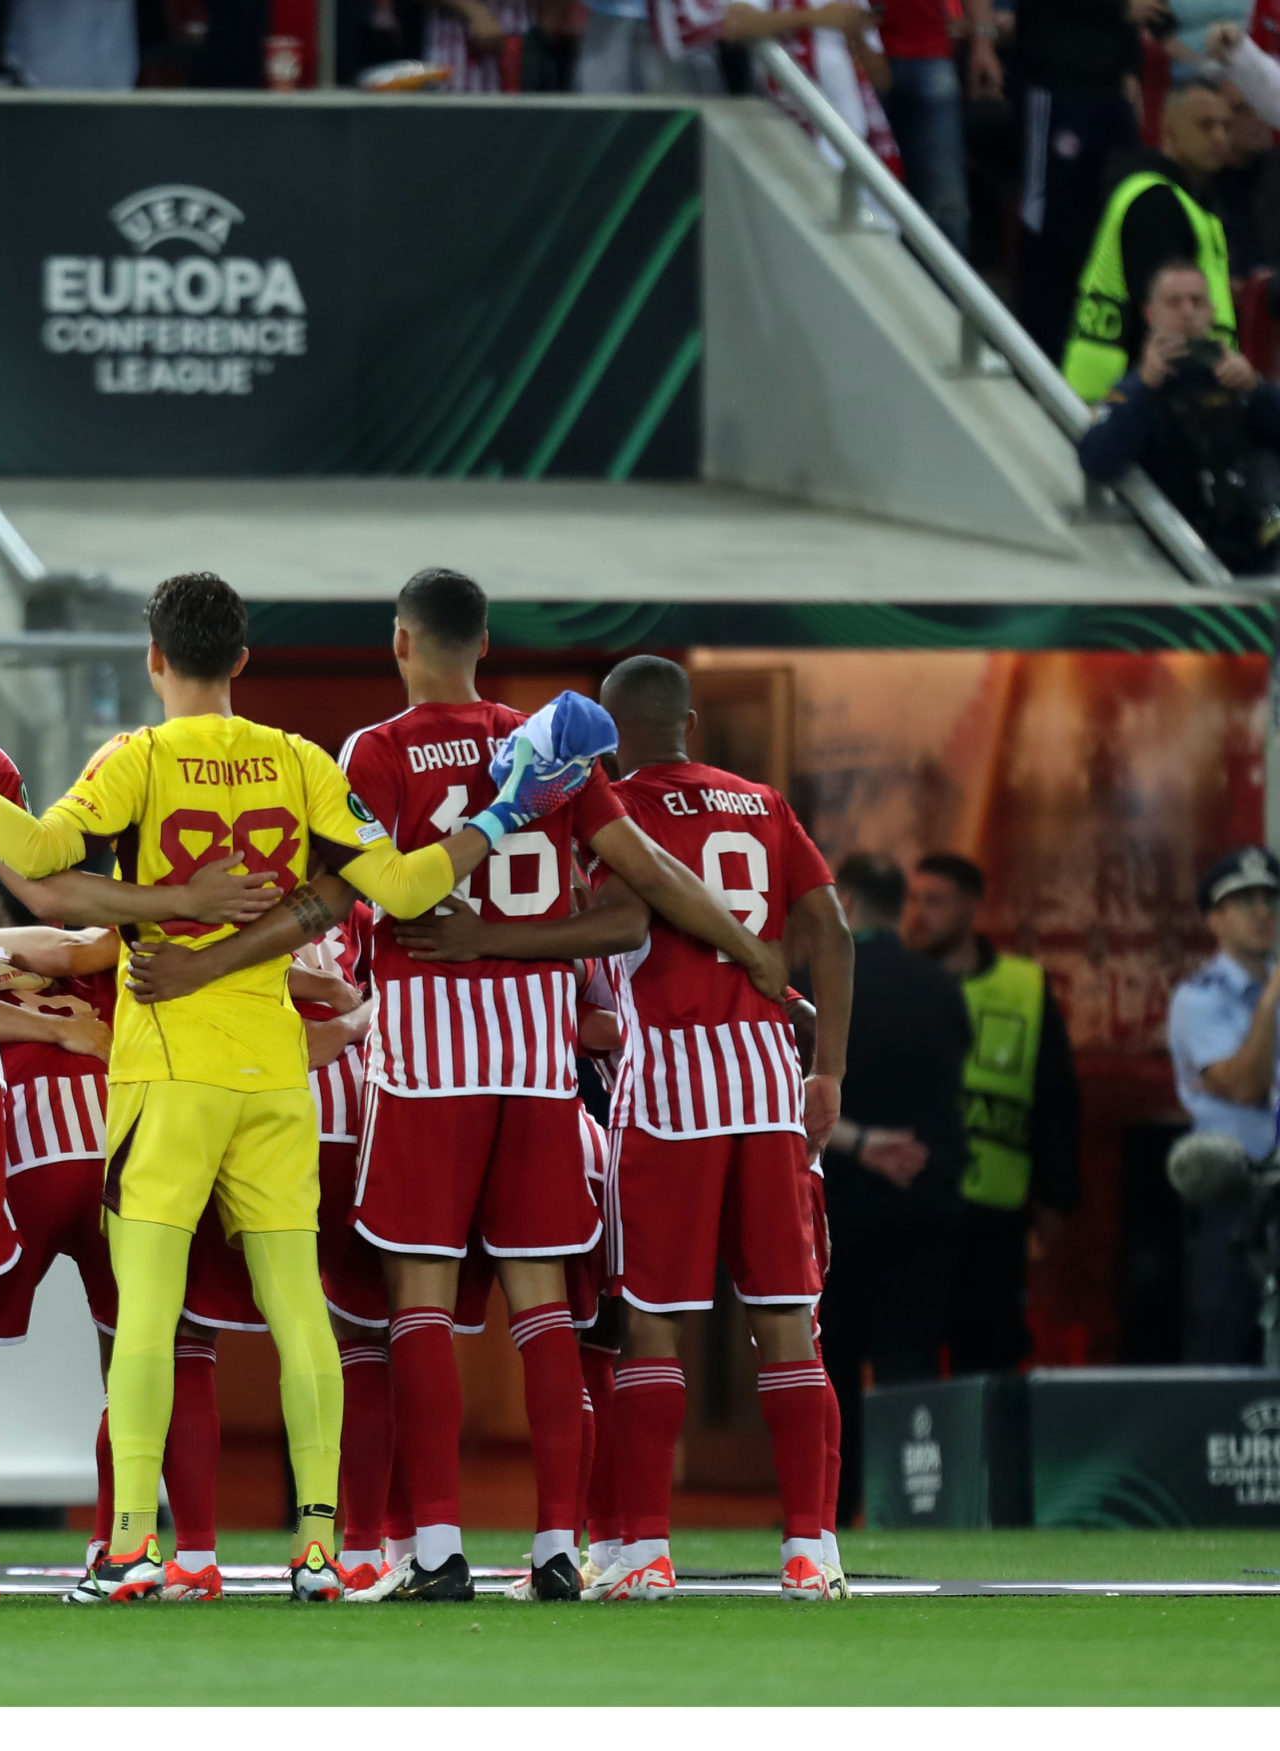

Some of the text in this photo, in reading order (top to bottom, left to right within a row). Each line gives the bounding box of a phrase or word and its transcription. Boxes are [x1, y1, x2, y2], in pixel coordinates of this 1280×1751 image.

[119, 199, 233, 246] UEFA
[43, 256, 306, 314] EUROPA
[42, 317, 307, 355] CONFERENCE
[95, 357, 253, 394] LEAGUE
[408, 738, 480, 774] DAVID
[663, 788, 769, 816] EL KAABI
